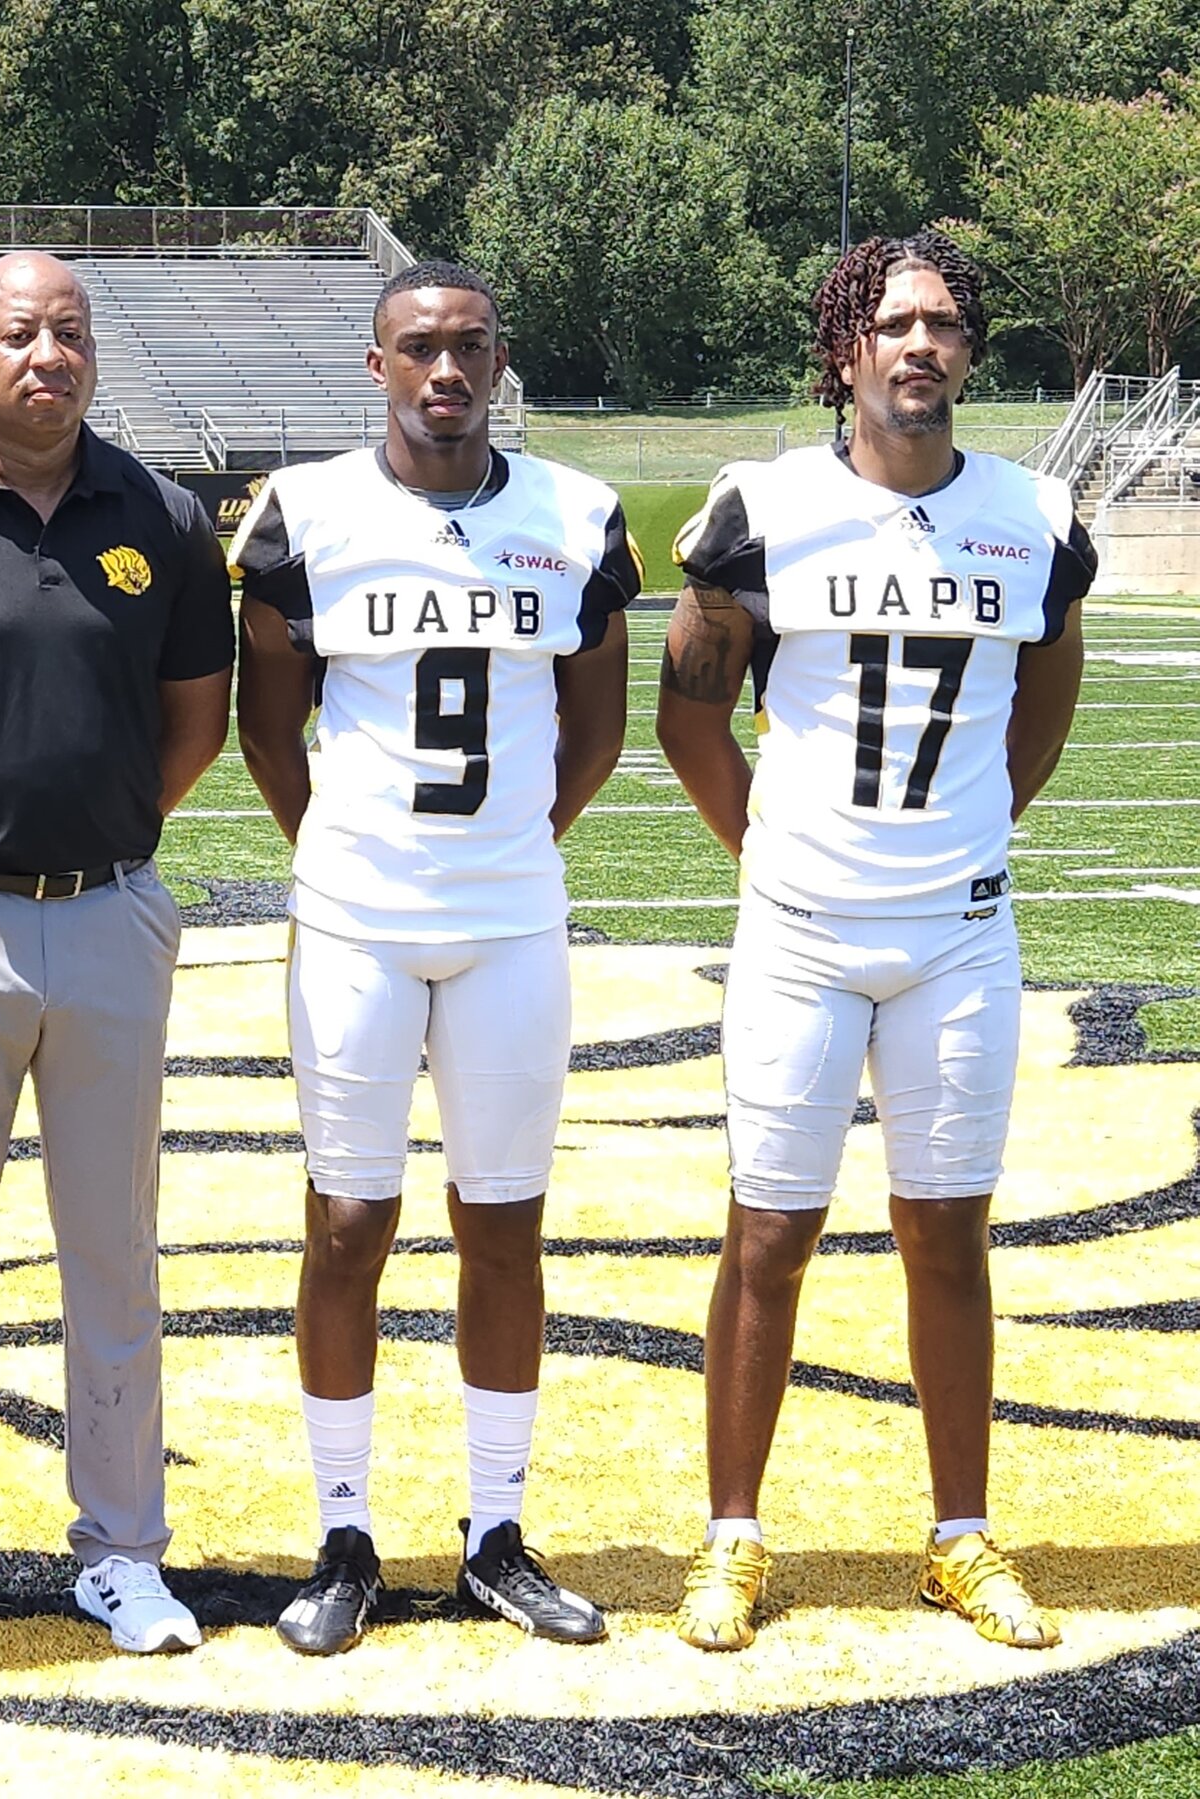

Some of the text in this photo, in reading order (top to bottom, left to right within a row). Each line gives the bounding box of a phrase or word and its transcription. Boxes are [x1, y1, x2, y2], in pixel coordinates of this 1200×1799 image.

[218, 499, 252, 516] UA
[514, 555, 568, 572] SWAC
[976, 542, 1032, 560] SWAC
[364, 588, 542, 637] UAPB
[826, 573, 1003, 625] UAPB
[411, 646, 493, 817] 9
[849, 632, 976, 810] 17
